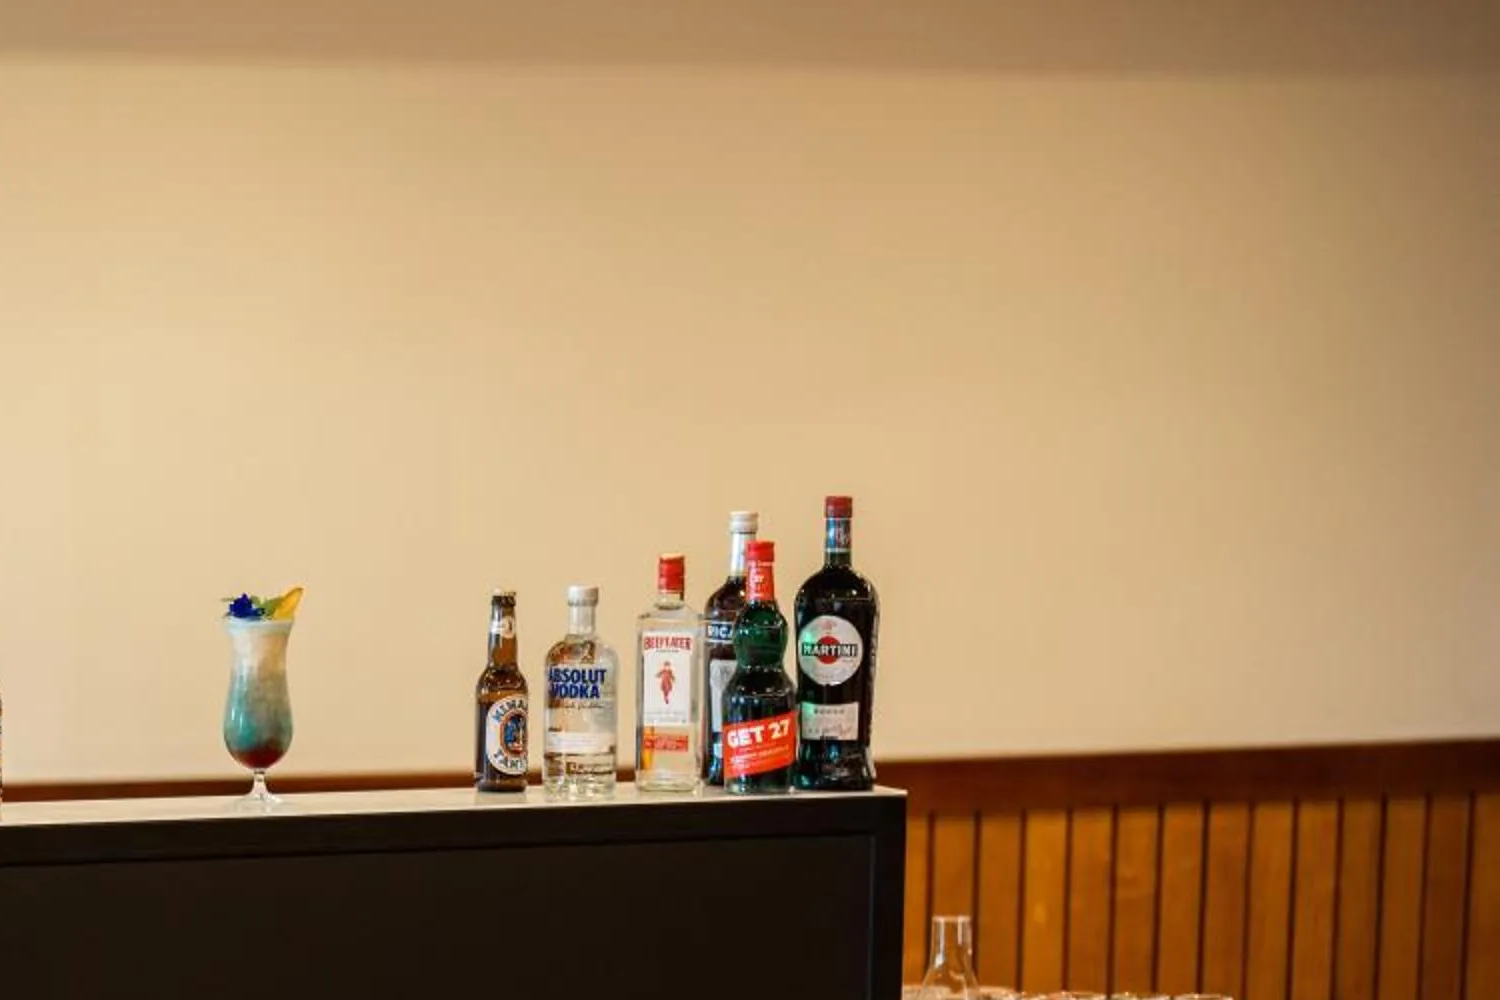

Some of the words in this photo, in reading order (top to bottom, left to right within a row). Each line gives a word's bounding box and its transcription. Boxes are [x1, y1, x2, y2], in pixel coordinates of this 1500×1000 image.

[643, 635, 691, 650] BEEFEATER
[802, 644, 858, 657] MARTINI
[550, 683, 600, 699] VODKA
[727, 725, 765, 749] GET
[768, 718, 789, 740] 27
